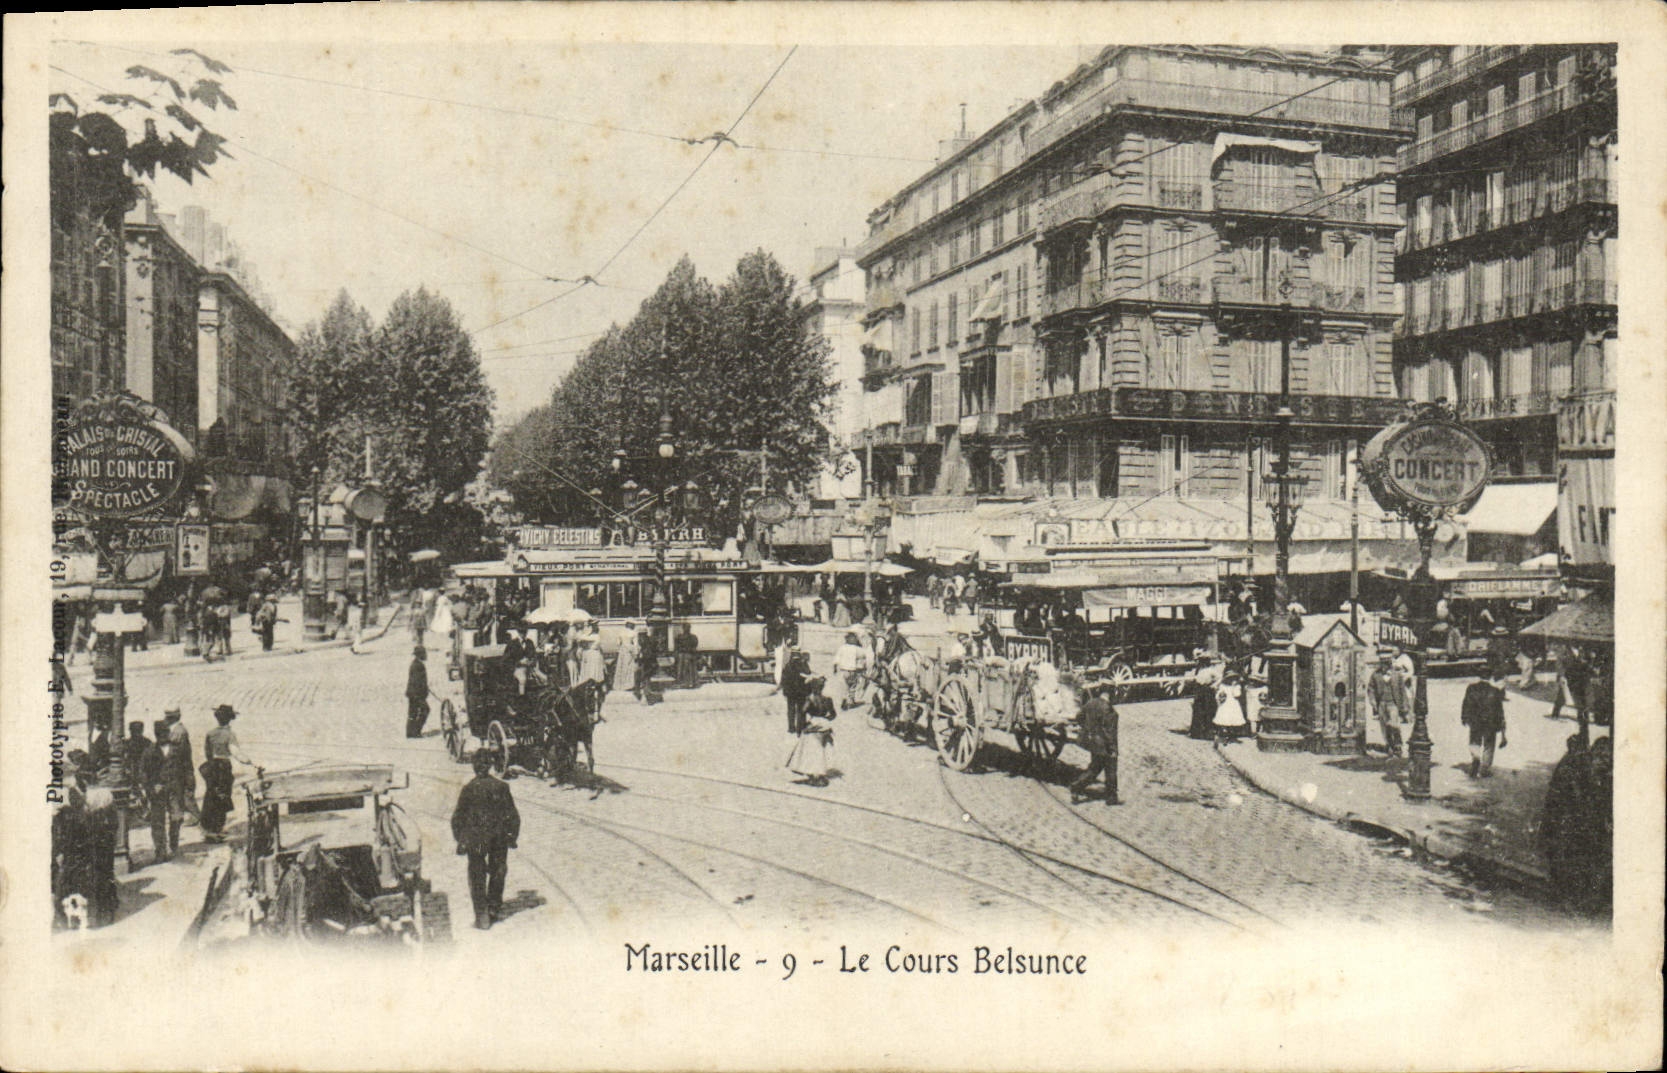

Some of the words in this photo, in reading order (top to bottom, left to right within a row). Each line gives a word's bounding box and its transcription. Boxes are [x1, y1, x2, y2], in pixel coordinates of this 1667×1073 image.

[116, 425, 166, 458] CRISTAL
[106, 459, 175, 480] CONCERT
[1394, 458, 1480, 481] CONCERT
[70, 480, 160, 509] SPECTACLE
[524, 527, 550, 545] VICHY
[552, 527, 601, 545] CELESTINS
[1126, 587, 1168, 602] MAGGI
[1380, 624, 1418, 646] BYRRH
[1007, 641, 1048, 663] BYRRH
